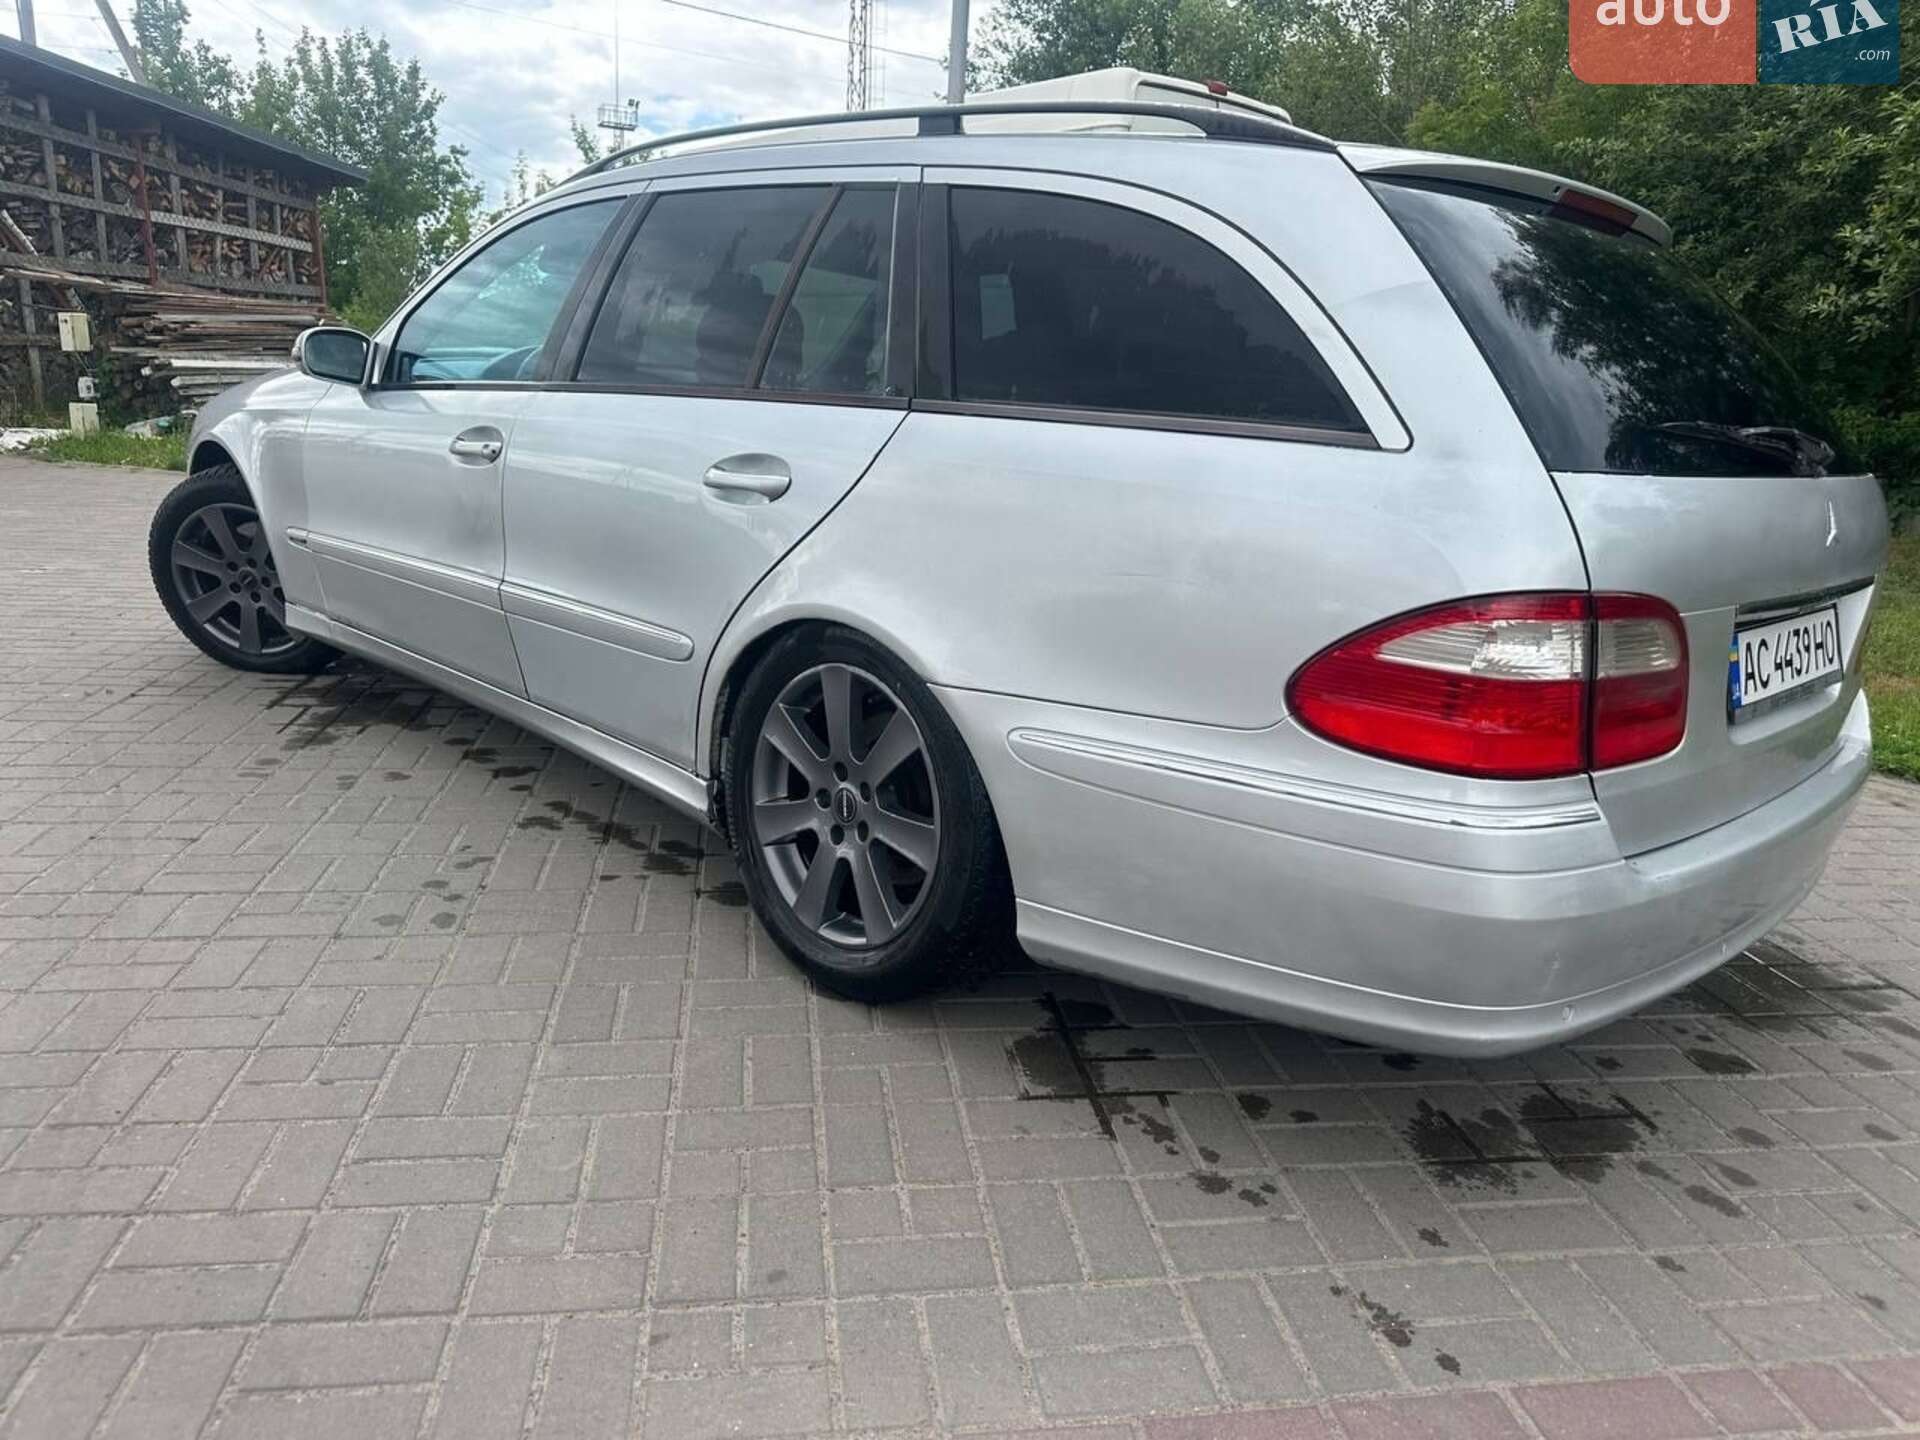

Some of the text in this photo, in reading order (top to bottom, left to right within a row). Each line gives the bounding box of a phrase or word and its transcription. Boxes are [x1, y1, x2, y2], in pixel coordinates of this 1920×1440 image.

[1744, 620, 1835, 695] AC 4439 HO
